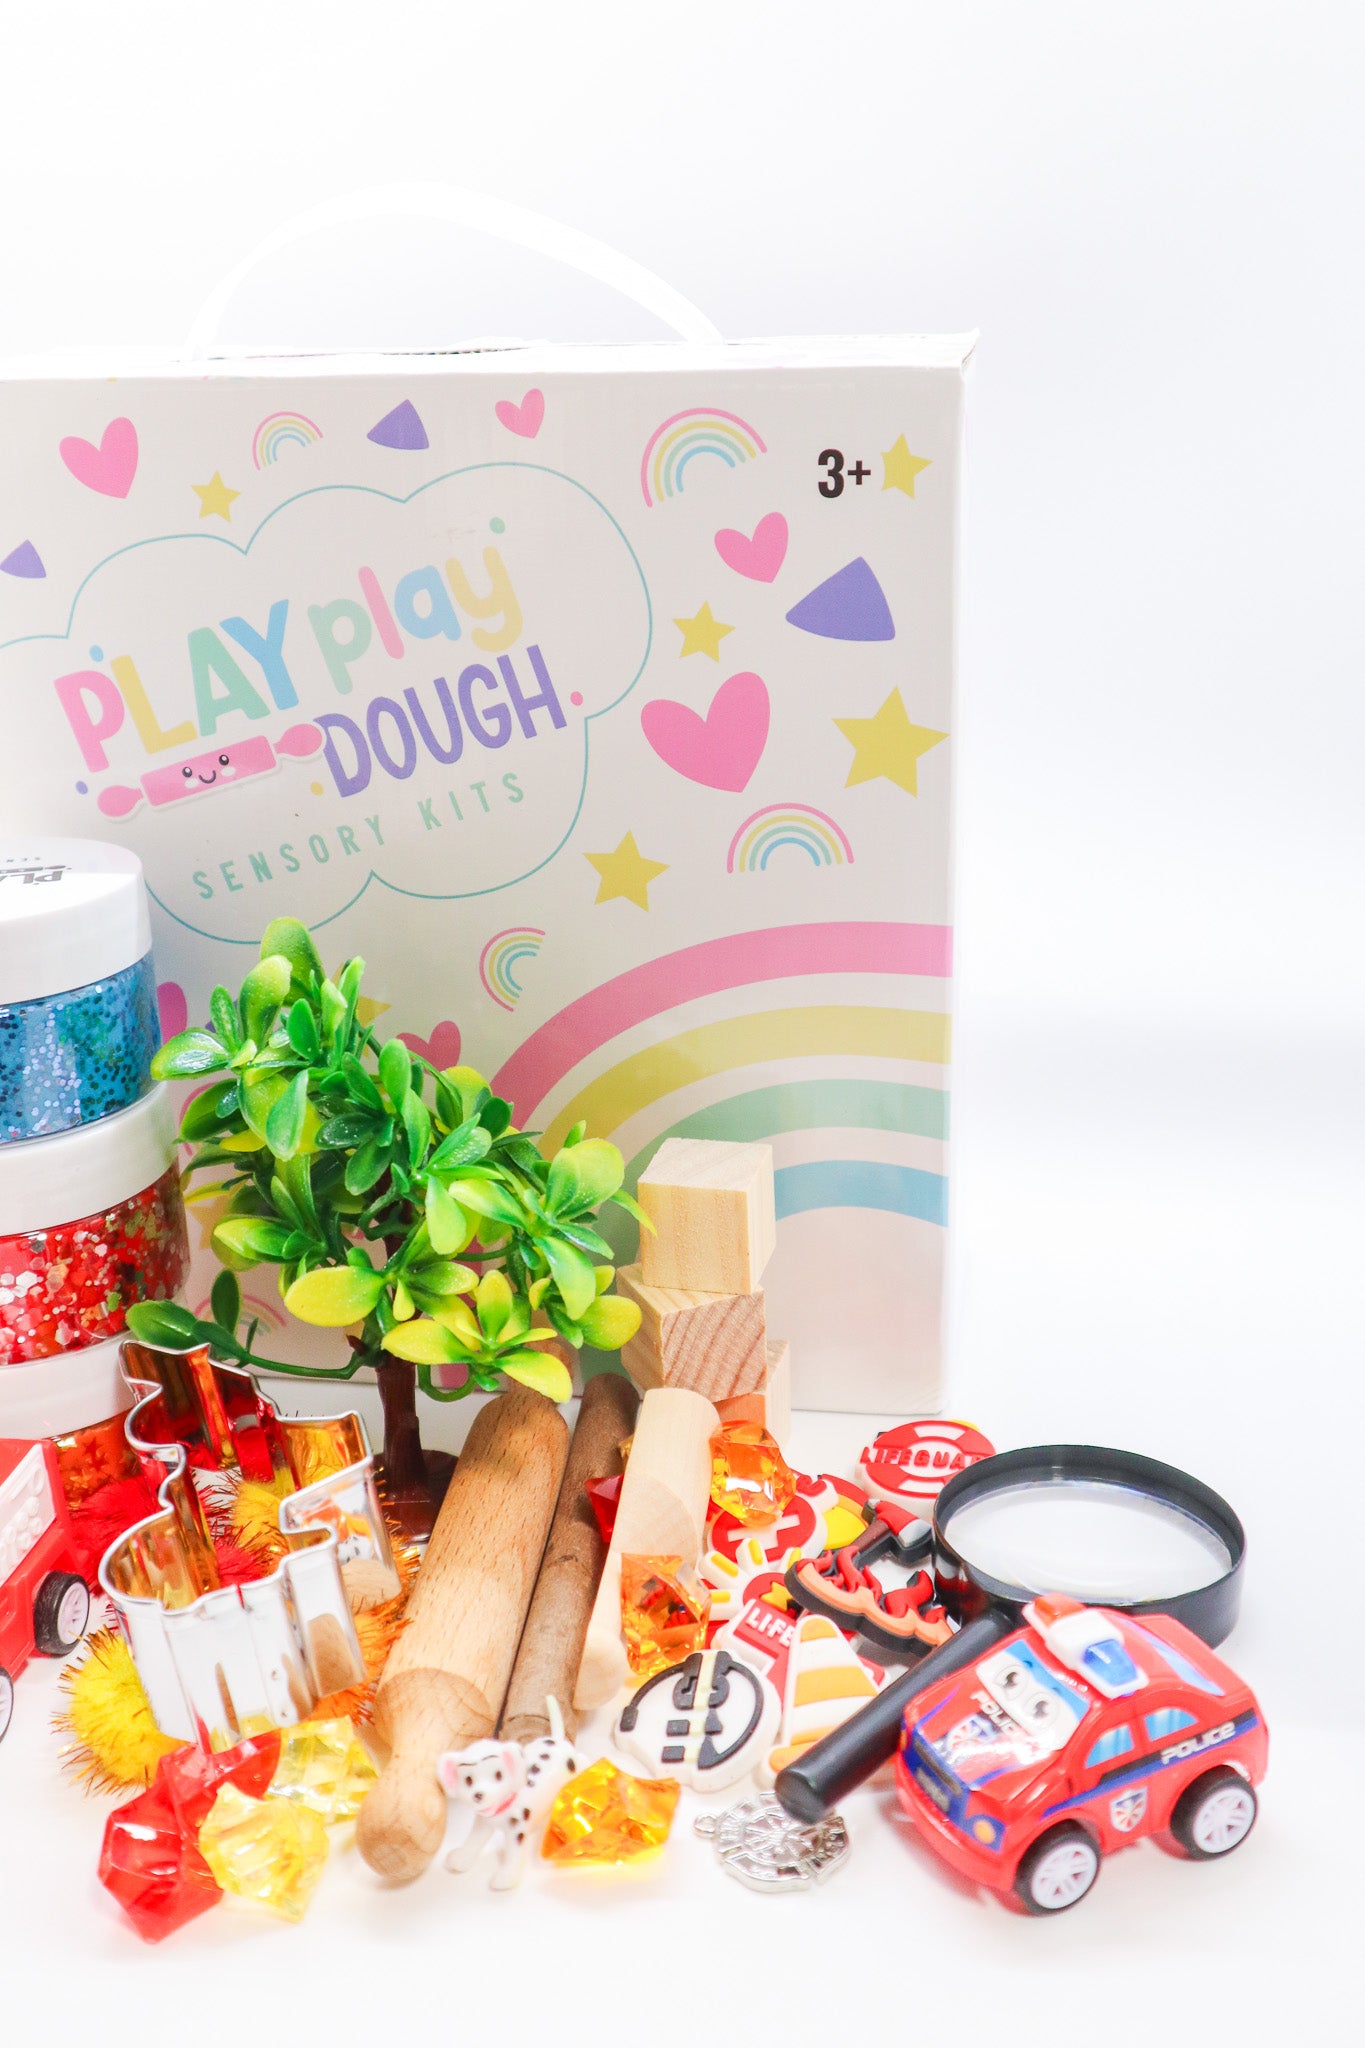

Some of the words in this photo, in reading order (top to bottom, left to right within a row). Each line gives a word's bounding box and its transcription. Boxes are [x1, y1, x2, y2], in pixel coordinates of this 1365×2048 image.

[817, 448, 872, 499] 3+
[54, 598, 300, 773] PLAY
[307, 546, 524, 695] play
[313, 644, 568, 798] DOUGH
[192, 814, 385, 900] SENSORY
[417, 772, 524, 830] KITS
[1160, 1720, 1236, 1765] POLICE
